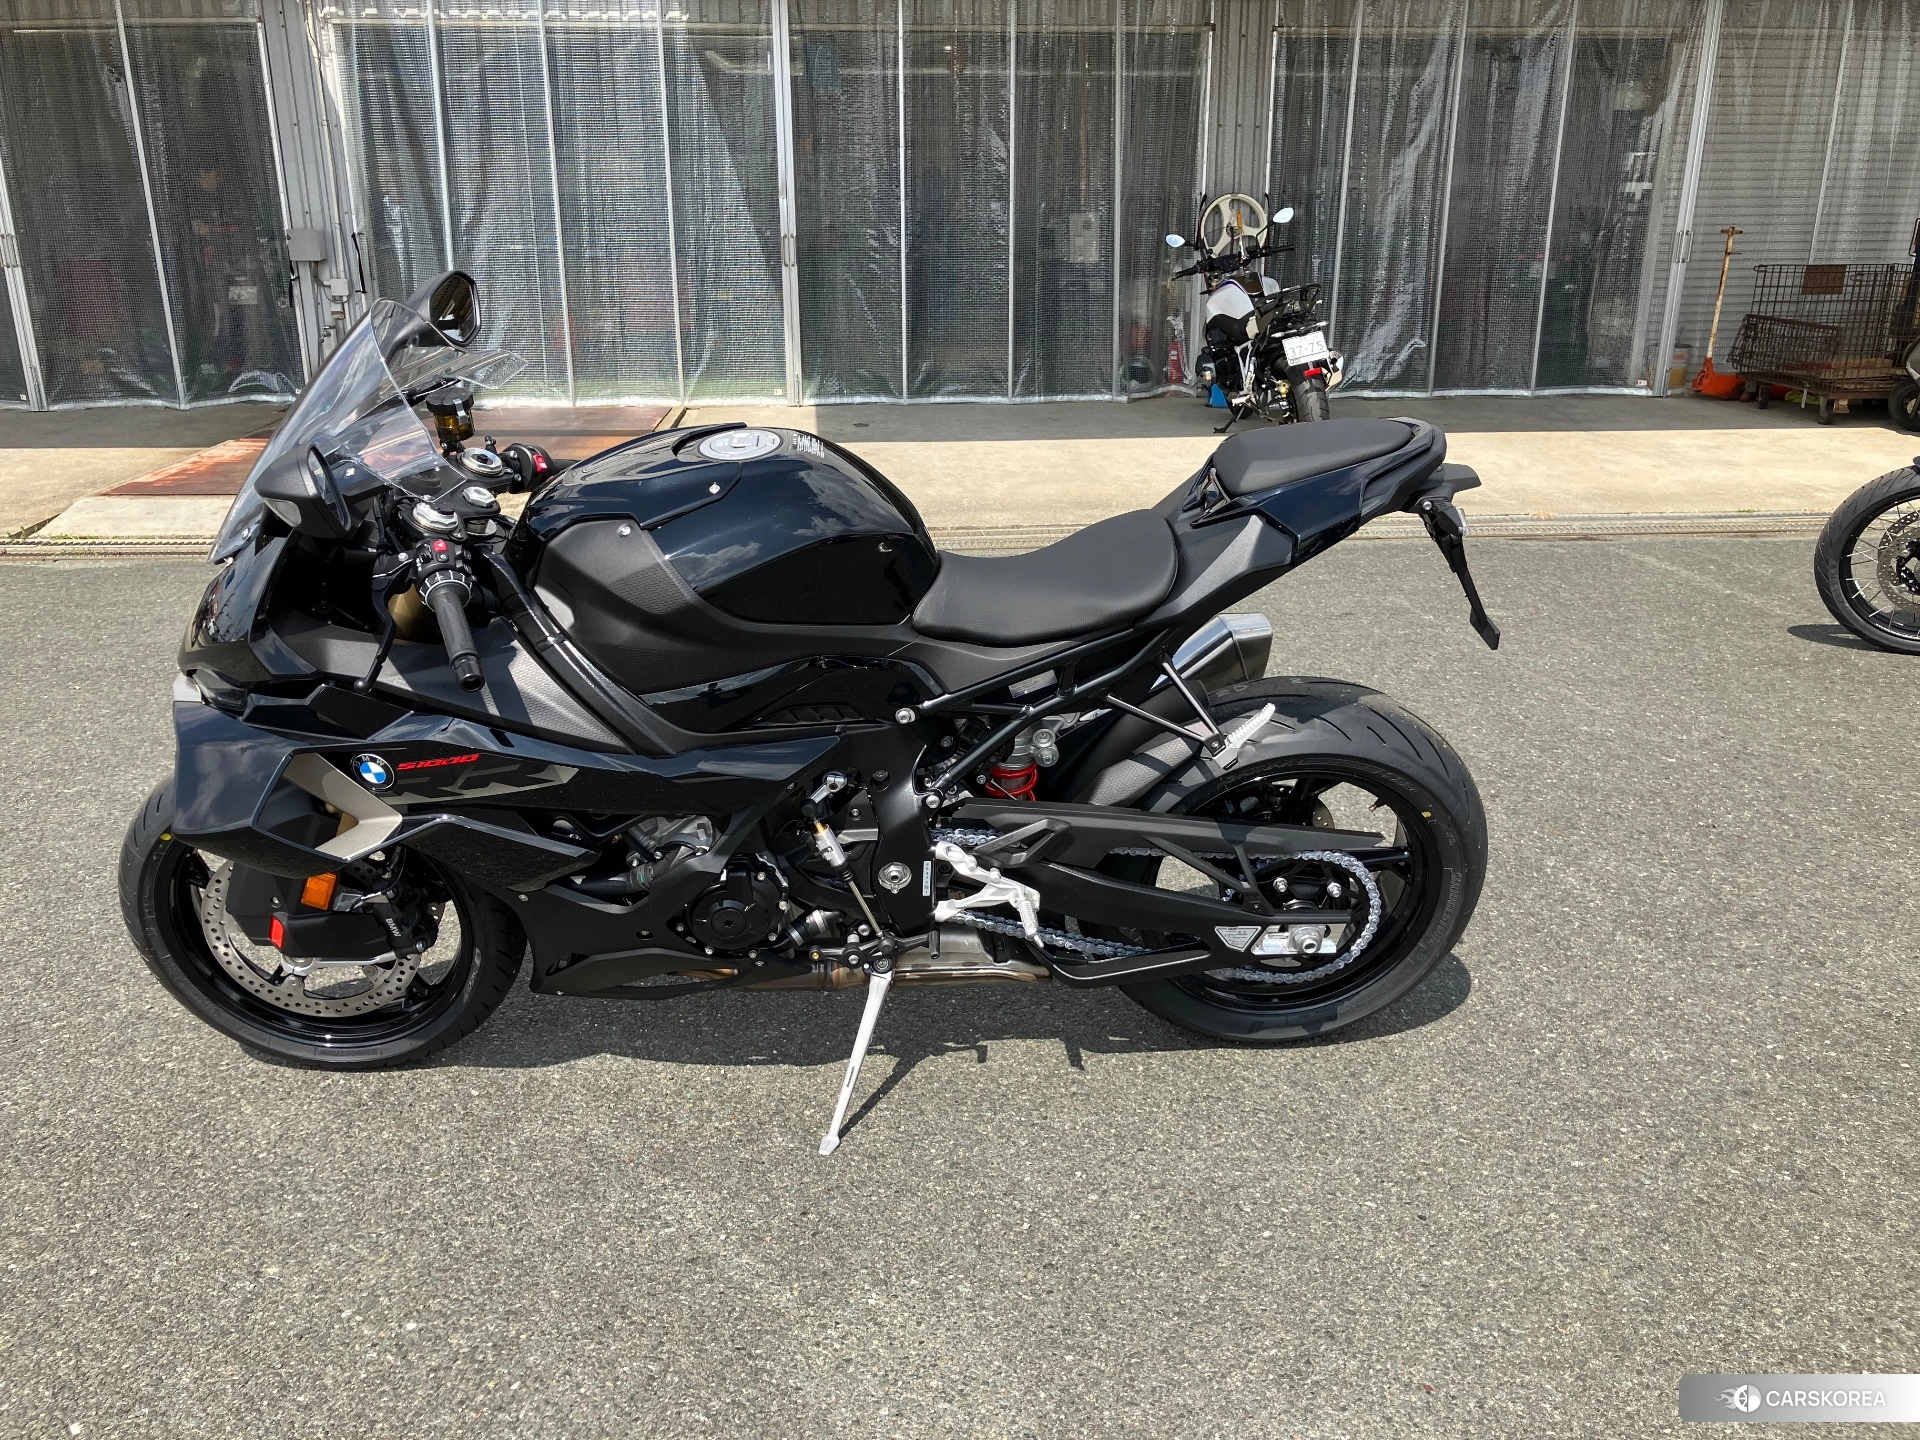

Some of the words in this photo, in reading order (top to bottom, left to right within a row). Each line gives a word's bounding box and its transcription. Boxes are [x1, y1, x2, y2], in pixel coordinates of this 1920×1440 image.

[354, 755, 386, 768] BMW
[396, 754, 480, 771] S1000
[385, 917, 402, 937] BMW
